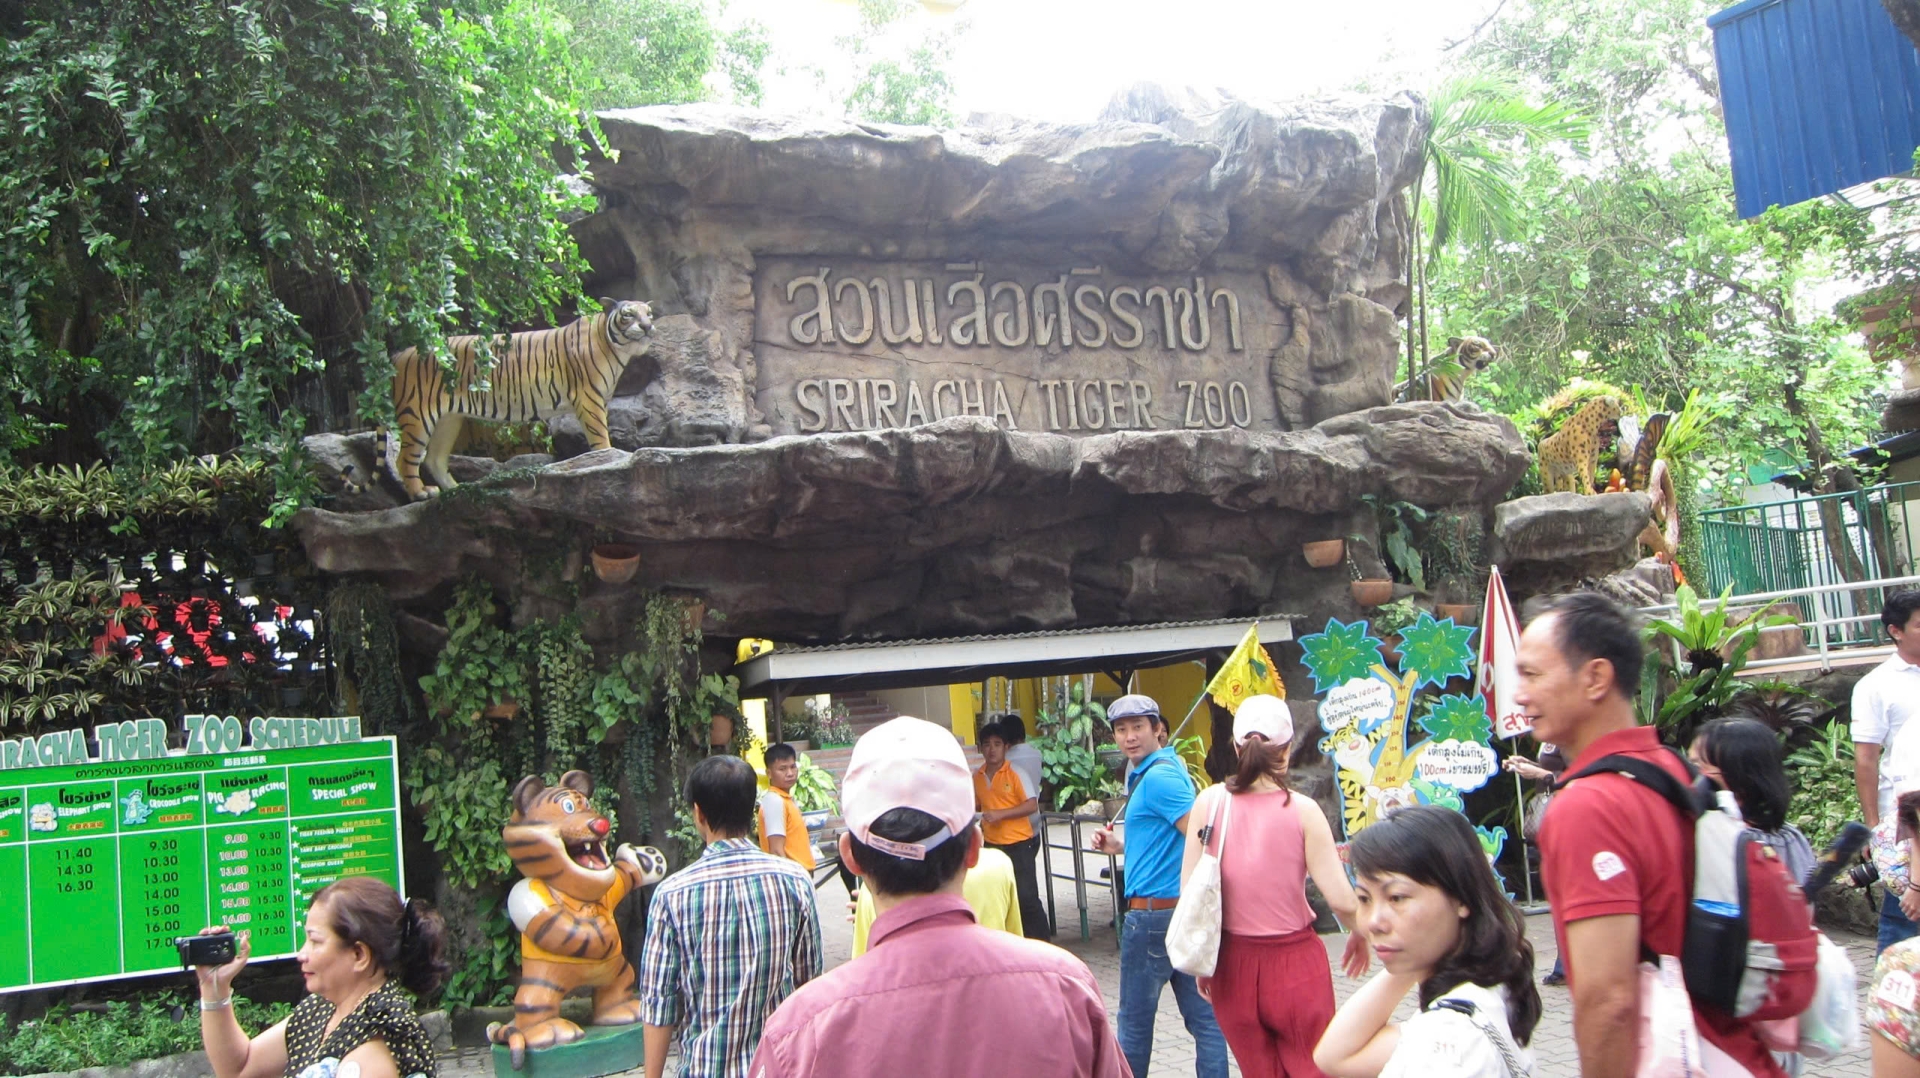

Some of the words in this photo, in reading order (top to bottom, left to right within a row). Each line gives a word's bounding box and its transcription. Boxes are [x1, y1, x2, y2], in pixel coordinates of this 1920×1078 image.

[787, 262, 1244, 351] สวนเสือศรีราชา
[797, 379, 1016, 432] SRIRACHA
[1038, 379, 1157, 430] TIGER
[1178, 380, 1253, 429] ZOO
[96, 718, 168, 762] TIGER
[184, 715, 243, 754] ZOO
[250, 716, 361, 751] SCHEDULE
[207, 791, 225, 804] PIG
[251, 781, 286, 798] RACING
[312, 788, 348, 800] SPECIAL
[350, 782, 377, 795] SHOW
[150, 798, 181, 809] CROCODILE
[182, 795, 199, 804] SHOW
[58, 805, 91, 817] ELEPHANT
[92, 802, 112, 811] SHOW
[225, 833, 248, 844] 9.00
[259, 831, 281, 840] 9.30
[149, 839, 178, 851] 9.30
[56, 847, 93, 861] 11.40
[219, 849, 249, 861] 10.00
[255, 847, 282, 857] 10.30
[143, 855, 179, 869] 10.30
[57, 863, 94, 876] 14.30
[220, 865, 249, 877] 13.00
[255, 863, 283, 873] 13.30
[144, 871, 179, 885] 13.00
[57, 880, 94, 893] 16.30
[220, 881, 250, 893] 14.00
[256, 878, 283, 889] 14.30
[144, 887, 179, 901] 14.00
[257, 894, 285, 905] 15.30
[145, 904, 180, 917] 15.00
[222, 913, 251, 925] 16.00
[258, 910, 285, 920] 16.30
[145, 920, 180, 934] 16.00
[258, 926, 286, 936] 17.30
[1884, 977, 1911, 998] 311
[1433, 1041, 1457, 1055] 311
